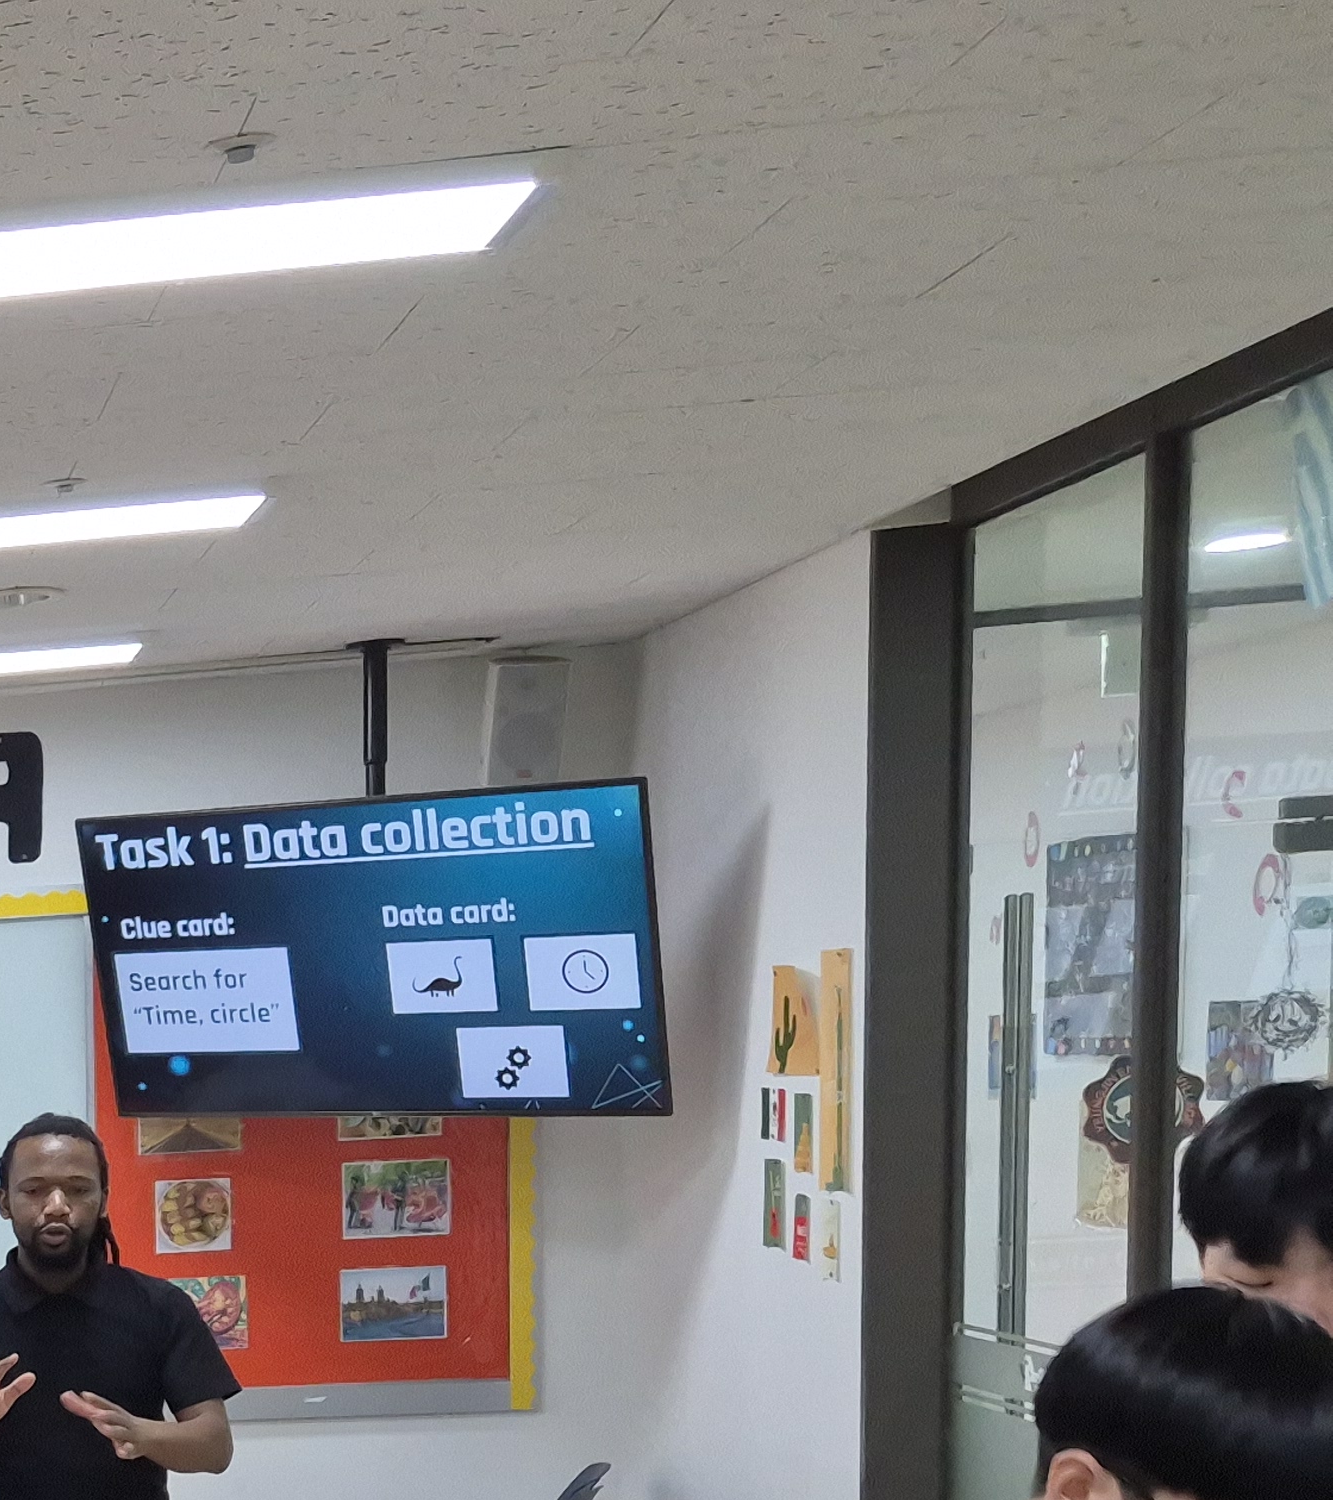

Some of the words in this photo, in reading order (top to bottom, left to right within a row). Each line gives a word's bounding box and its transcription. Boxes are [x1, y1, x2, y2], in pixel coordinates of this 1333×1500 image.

[95, 826, 194, 871] Task
[201, 827, 233, 863] 1:
[244, 821, 349, 862] Data
[361, 801, 592, 855] collection
[120, 916, 171, 940] Clue
[176, 912, 236, 938] card:
[381, 903, 442, 928] Data
[450, 897, 517, 924] card:
[129, 969, 208, 993] Search
[213, 968, 248, 990] for
